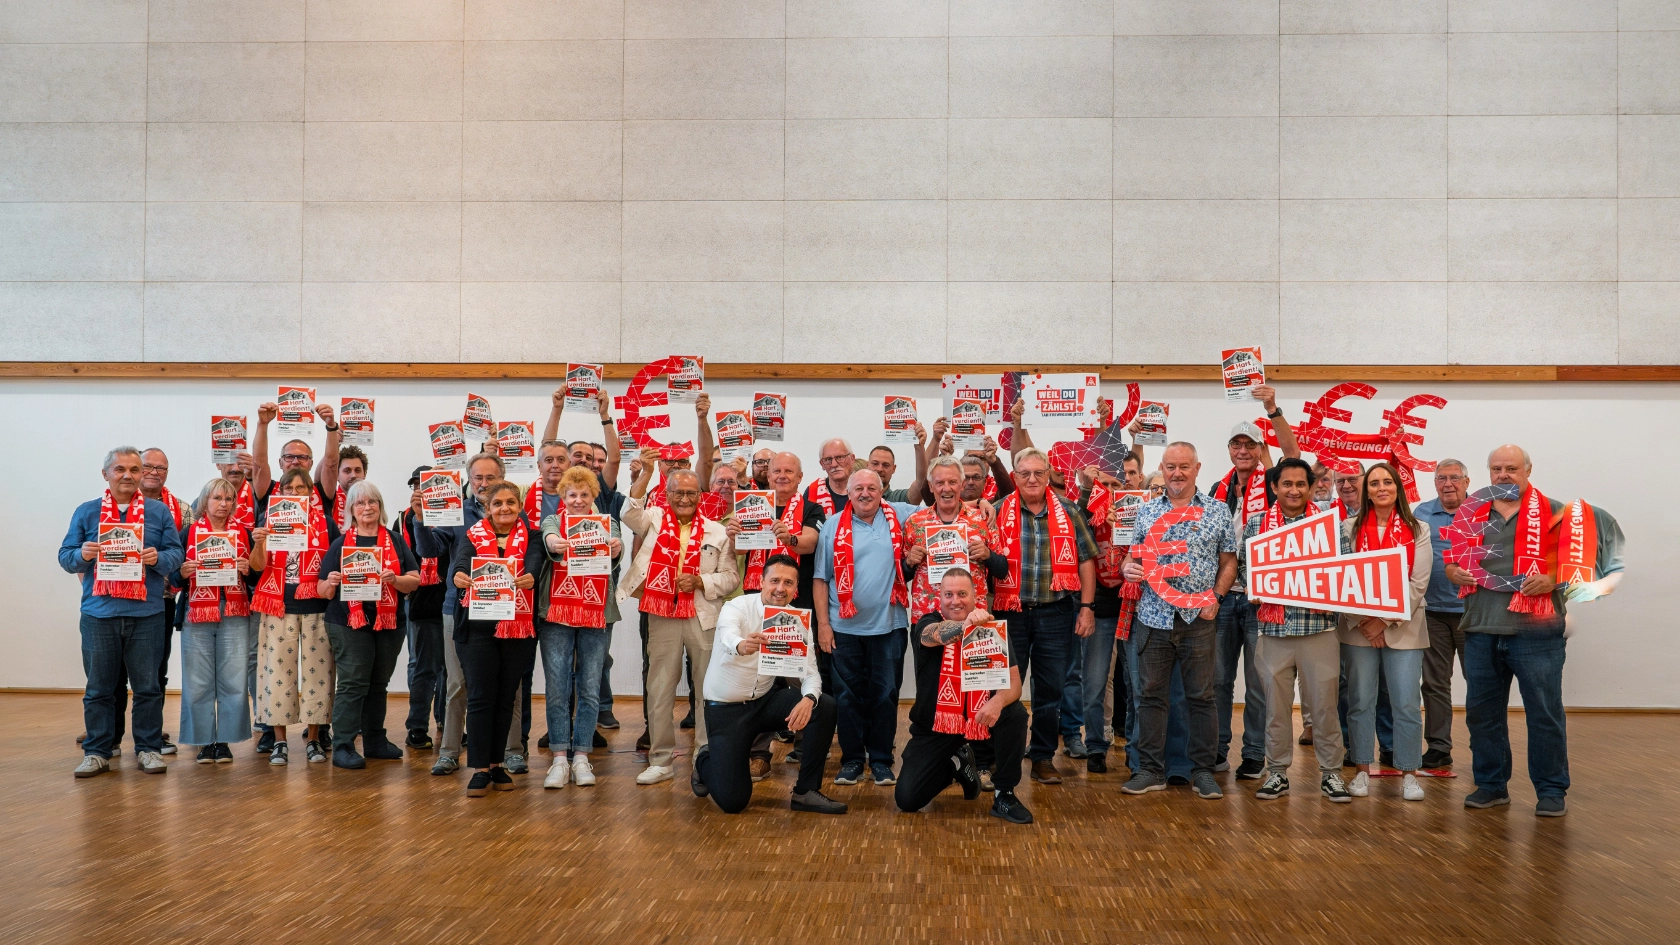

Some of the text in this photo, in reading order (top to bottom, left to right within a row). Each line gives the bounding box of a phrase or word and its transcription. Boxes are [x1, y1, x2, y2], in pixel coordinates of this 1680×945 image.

[1236, 360, 1251, 369] Hart
[1227, 366, 1258, 376] verdient!
[1042, 402, 1074, 411] ZÄHLST
[721, 428, 748, 438] verdient!
[434, 438, 461, 448] verdient!
[424, 490, 456, 499] verdient!
[571, 536, 605, 545] verdient!
[1254, 522, 1330, 564] TEAM
[930, 545, 962, 554] verdient!
[474, 580, 510, 588] verdient!
[1256, 562, 1398, 607] IG METALL
[976, 639, 993, 647] Hart
[965, 646, 1001, 656] verdient!
